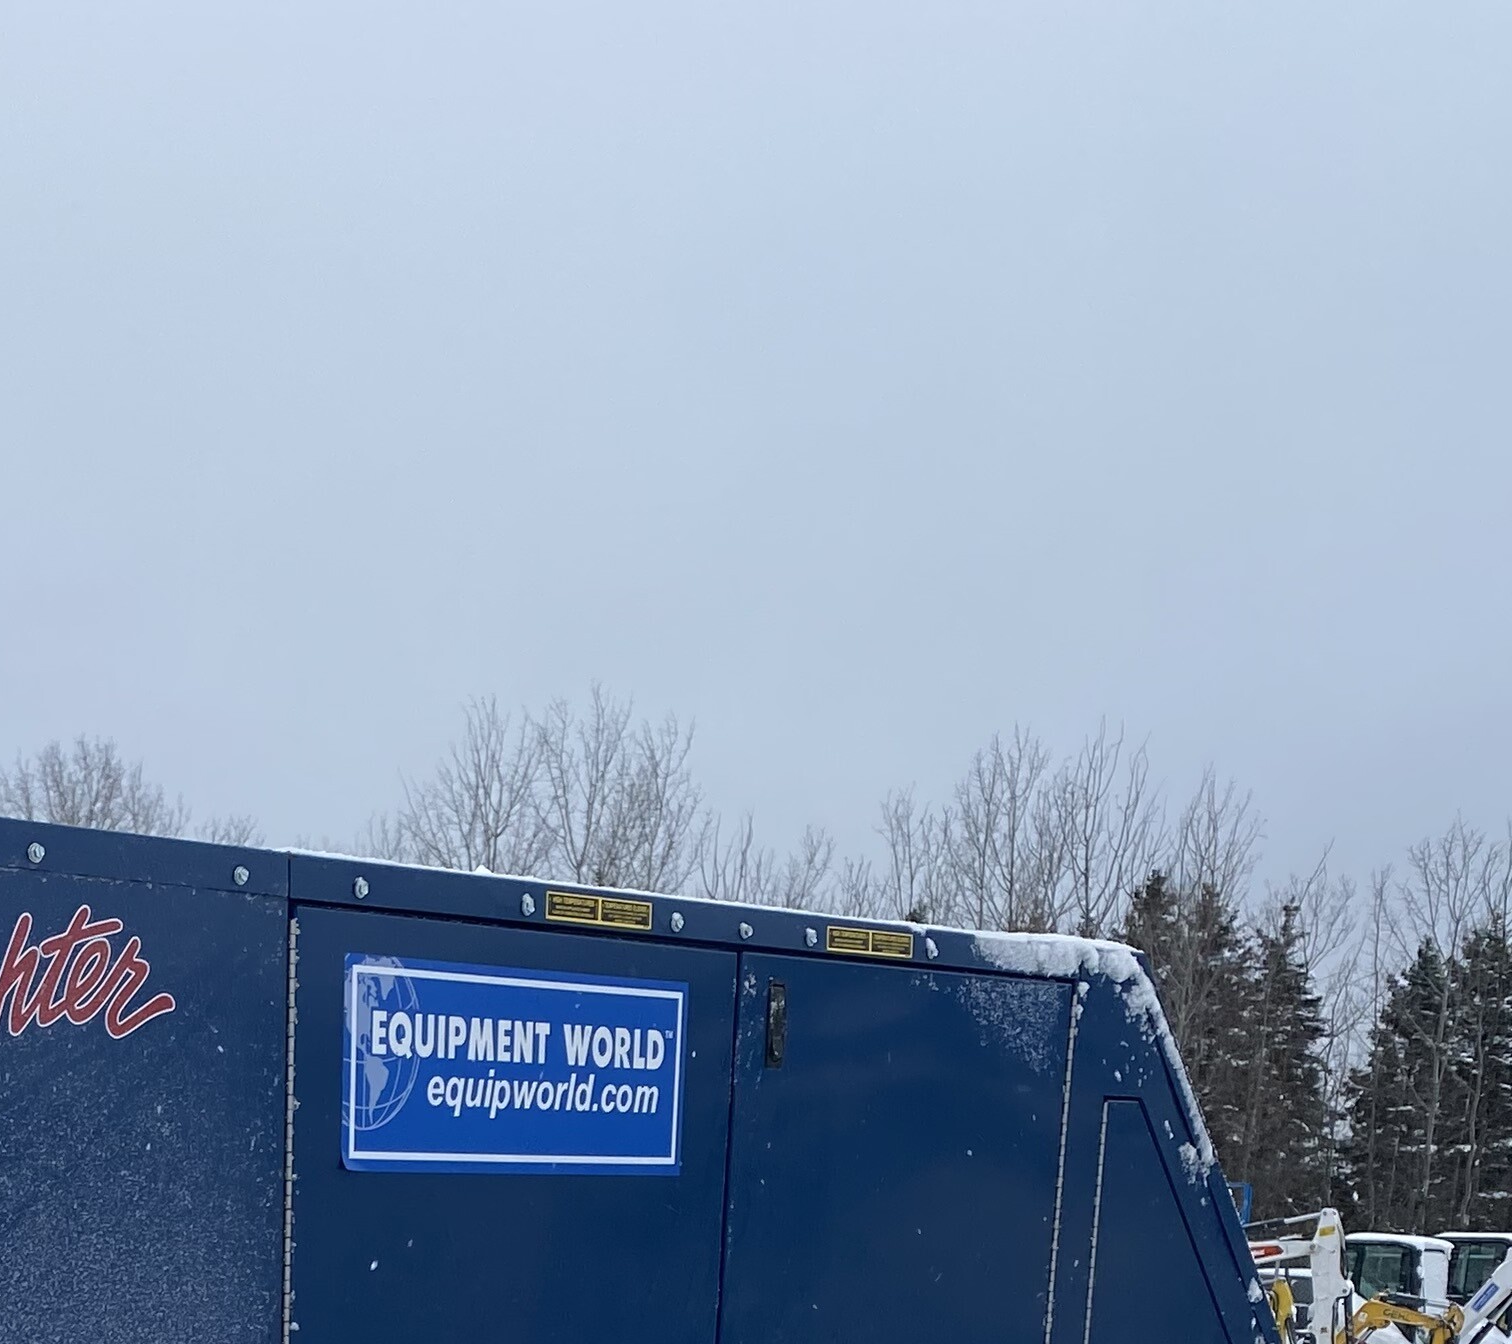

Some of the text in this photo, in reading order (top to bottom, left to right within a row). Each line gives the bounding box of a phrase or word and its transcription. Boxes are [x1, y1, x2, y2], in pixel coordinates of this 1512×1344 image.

[371, 1009, 551, 1065] EQUIPMENT
[564, 1024, 665, 1071] WORLD
[426, 1068, 660, 1120] equipworld.com
